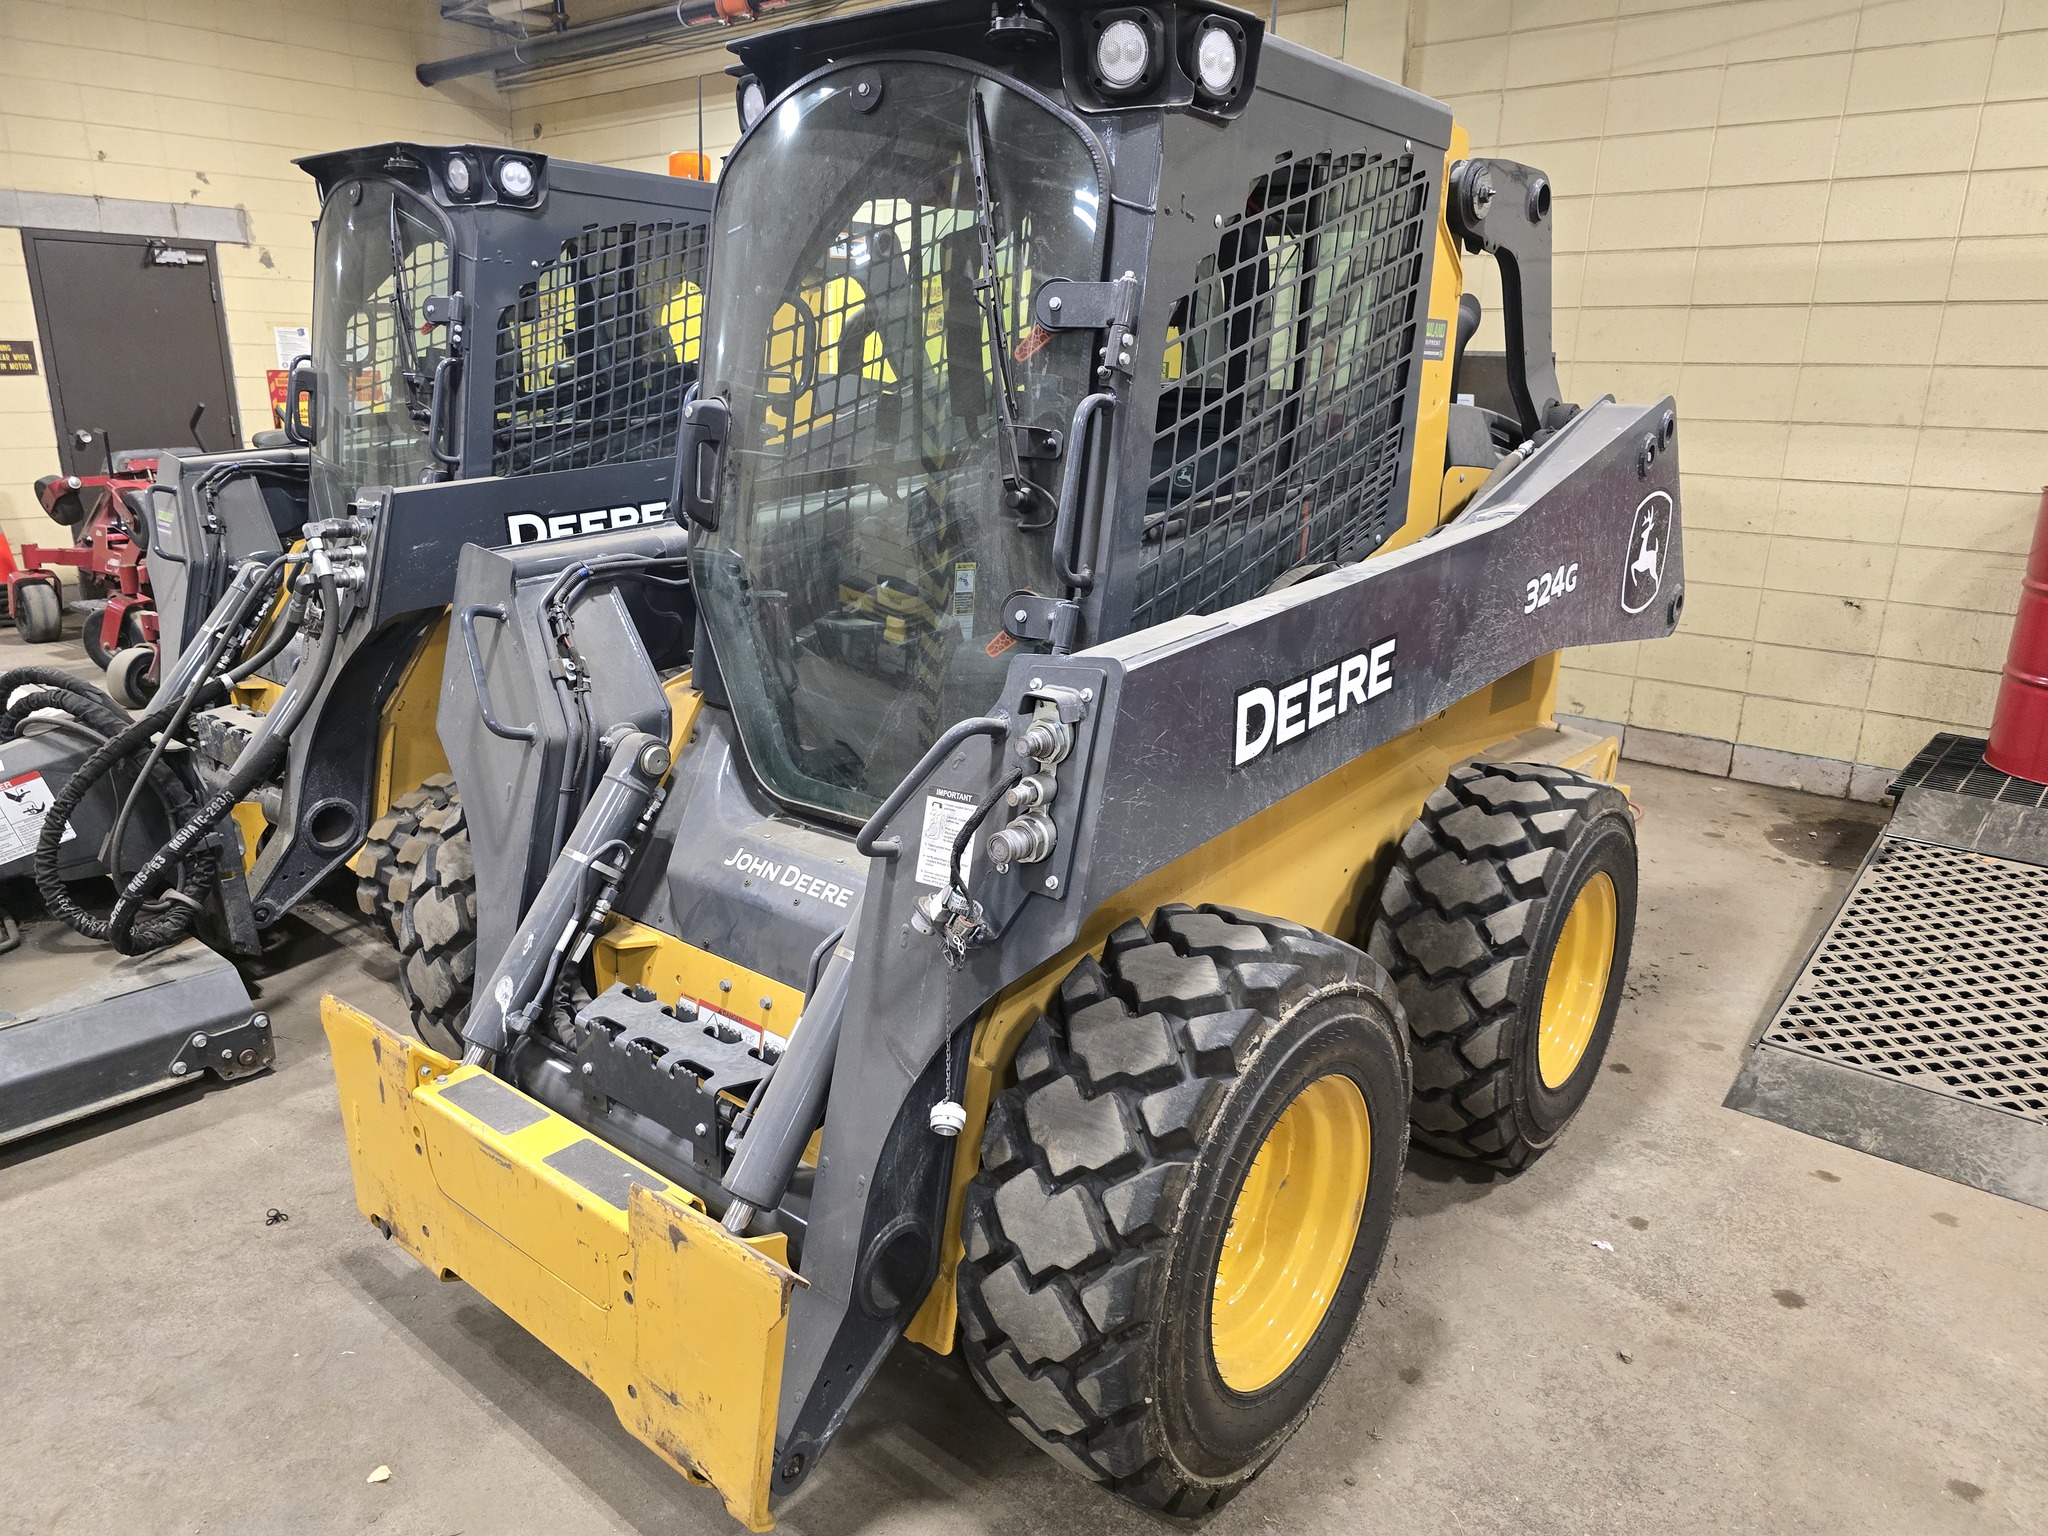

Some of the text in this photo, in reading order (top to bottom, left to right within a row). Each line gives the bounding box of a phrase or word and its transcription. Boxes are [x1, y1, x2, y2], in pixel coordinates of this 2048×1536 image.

[1524, 563, 1579, 614] 324G
[1235, 638, 1396, 766] DEERE
[936, 788, 973, 803] IMPORTANT
[168, 823, 199, 851] MSHA
[723, 847, 855, 908] JOHN DEERE
